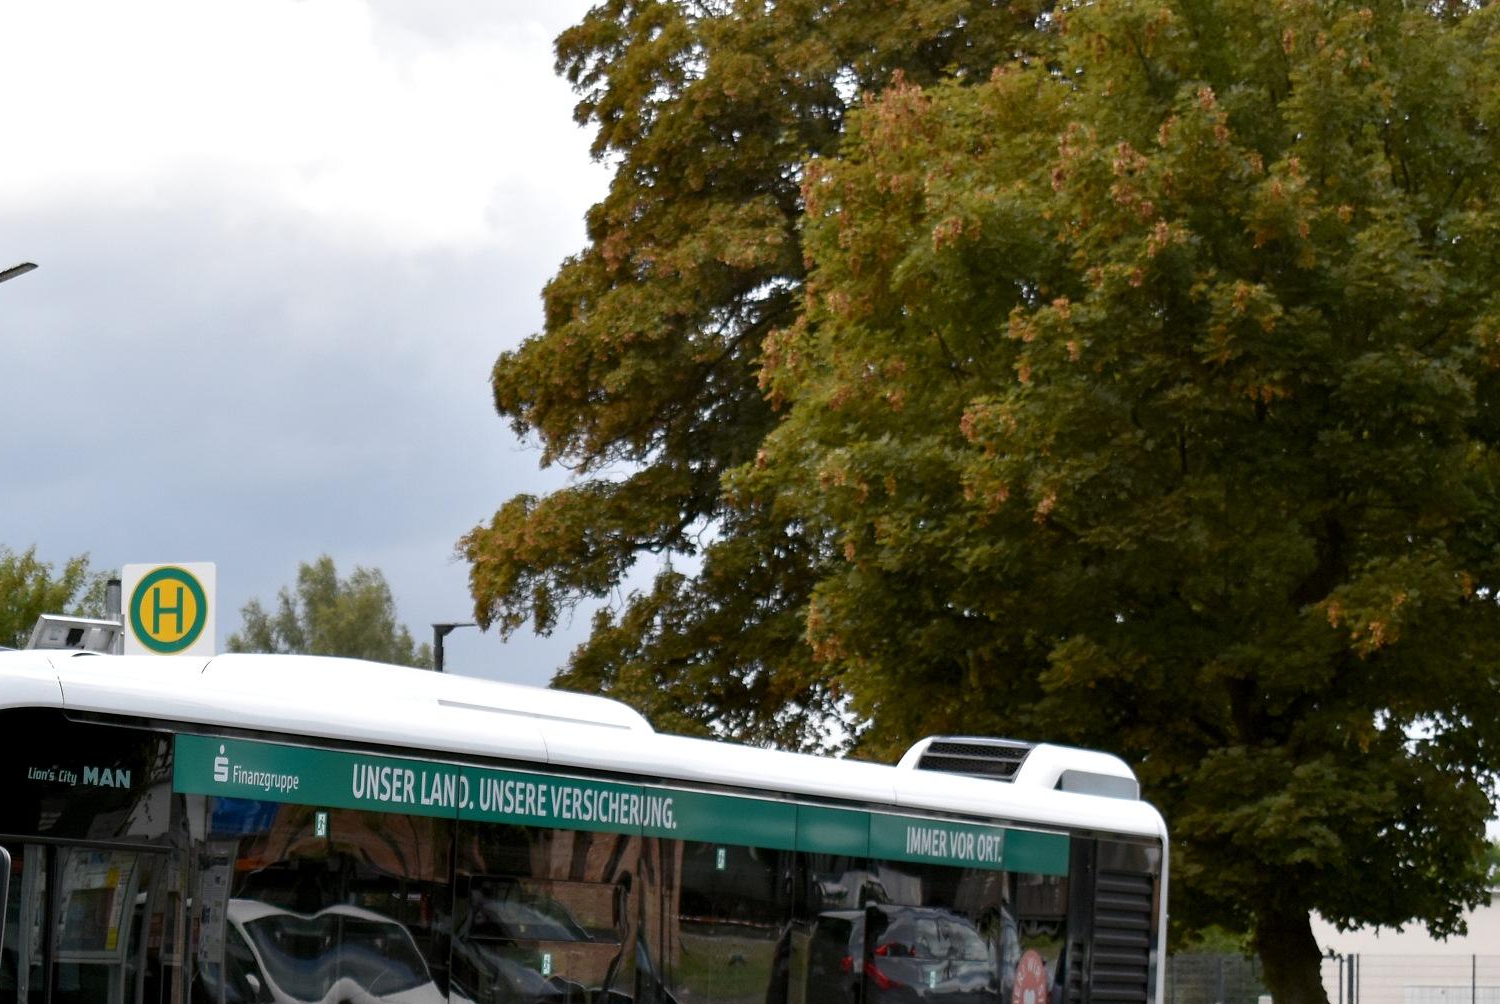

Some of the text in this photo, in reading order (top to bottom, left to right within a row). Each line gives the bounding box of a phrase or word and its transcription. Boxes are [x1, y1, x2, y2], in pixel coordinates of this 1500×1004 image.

[153, 587, 183, 634] H
[27, 765, 131, 789] Lion's City MAN
[232, 765, 299, 792] Finanzgruppe
[352, 762, 677, 830] UNSER LAND. UNSERE VERSICHERUNG.
[906, 826, 1002, 863] IMMER VOR ORT.
